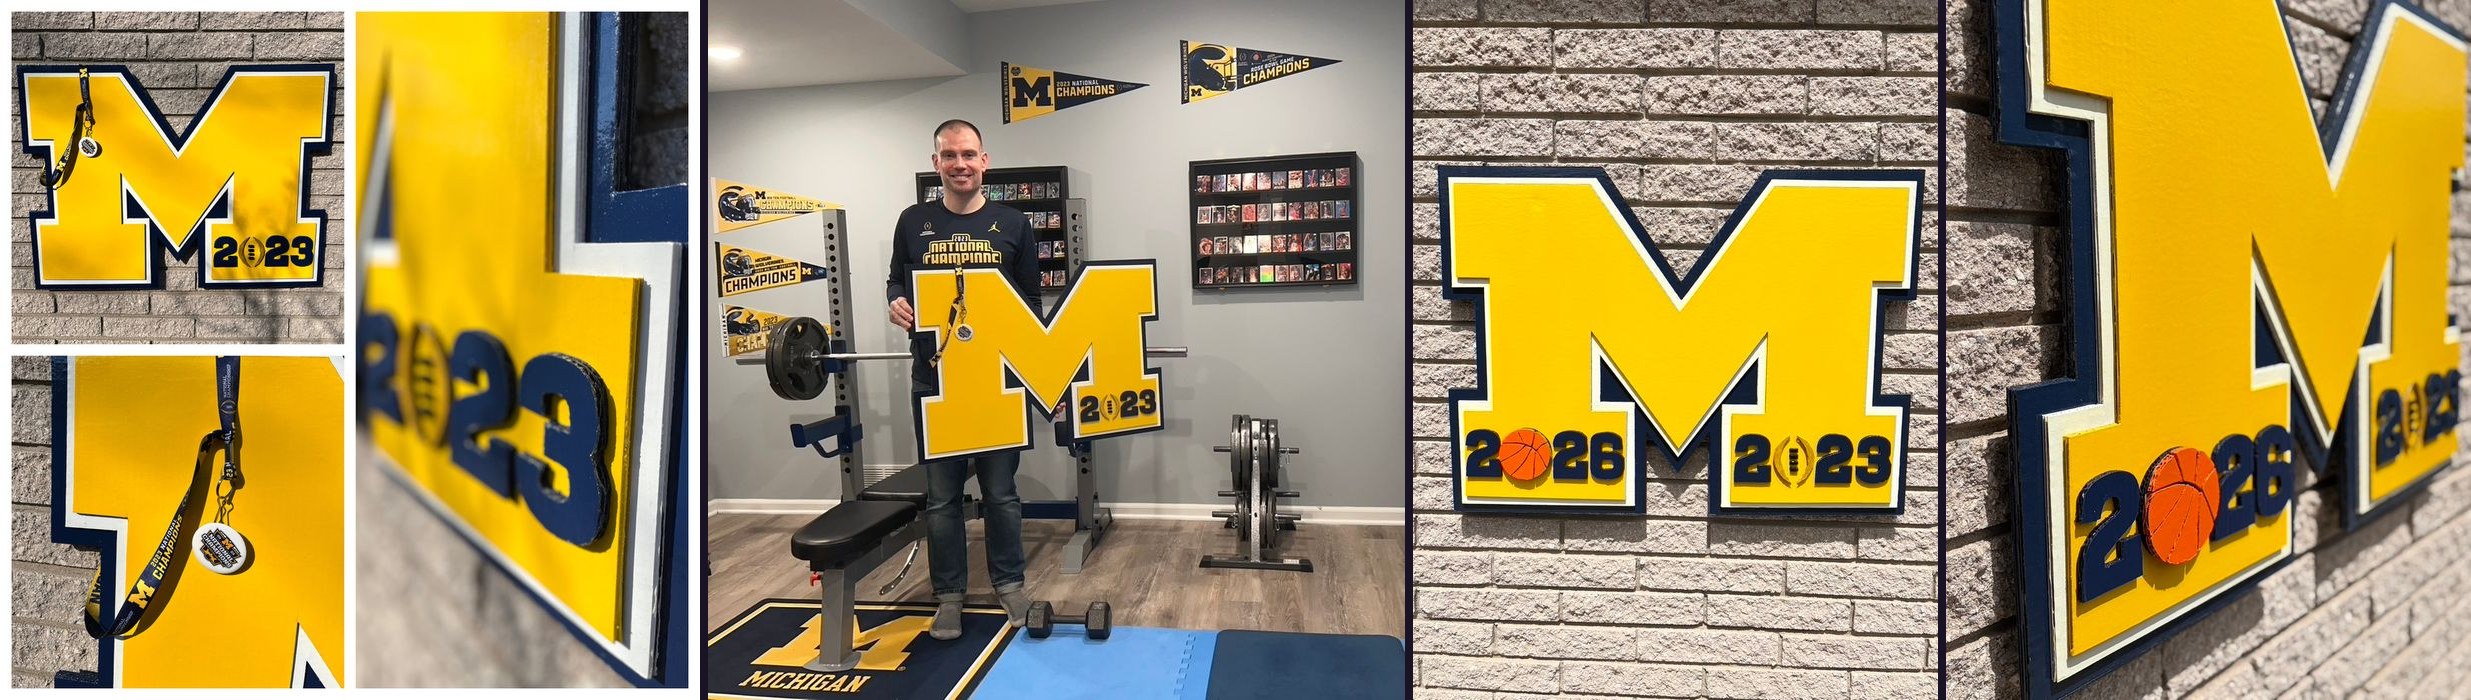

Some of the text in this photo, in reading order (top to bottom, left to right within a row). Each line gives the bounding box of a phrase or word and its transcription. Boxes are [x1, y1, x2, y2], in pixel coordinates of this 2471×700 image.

[1243, 57, 1310, 85] CHAMPIONS
[1250, 65, 1264, 73] ROSE
[1264, 61, 1279, 69] BOWL
[1279, 56, 1294, 65] GAME
[1012, 76, 1052, 107] M
[1056, 84, 1115, 97] CHAMPIONS
[1190, 88, 1202, 97] M
[754, 191, 766, 200] M
[760, 200, 814, 211] CHAMPIONS
[931, 242, 992, 253] NATIONAL
[755, 259, 784, 268] WOLVERINES
[801, 267, 812, 276] M
[725, 269, 796, 293] CHAMPIONS
[763, 316, 778, 326] 2023
[151, 519, 178, 568] 2023 NATIONAL
[152, 514, 183, 581] CHAMPIONS
[202, 534, 233, 568] CHAMPIONS
[209, 533, 233, 564] NATIONAL
[128, 579, 156, 609] M
[738, 670, 871, 693] MICHIGAN
